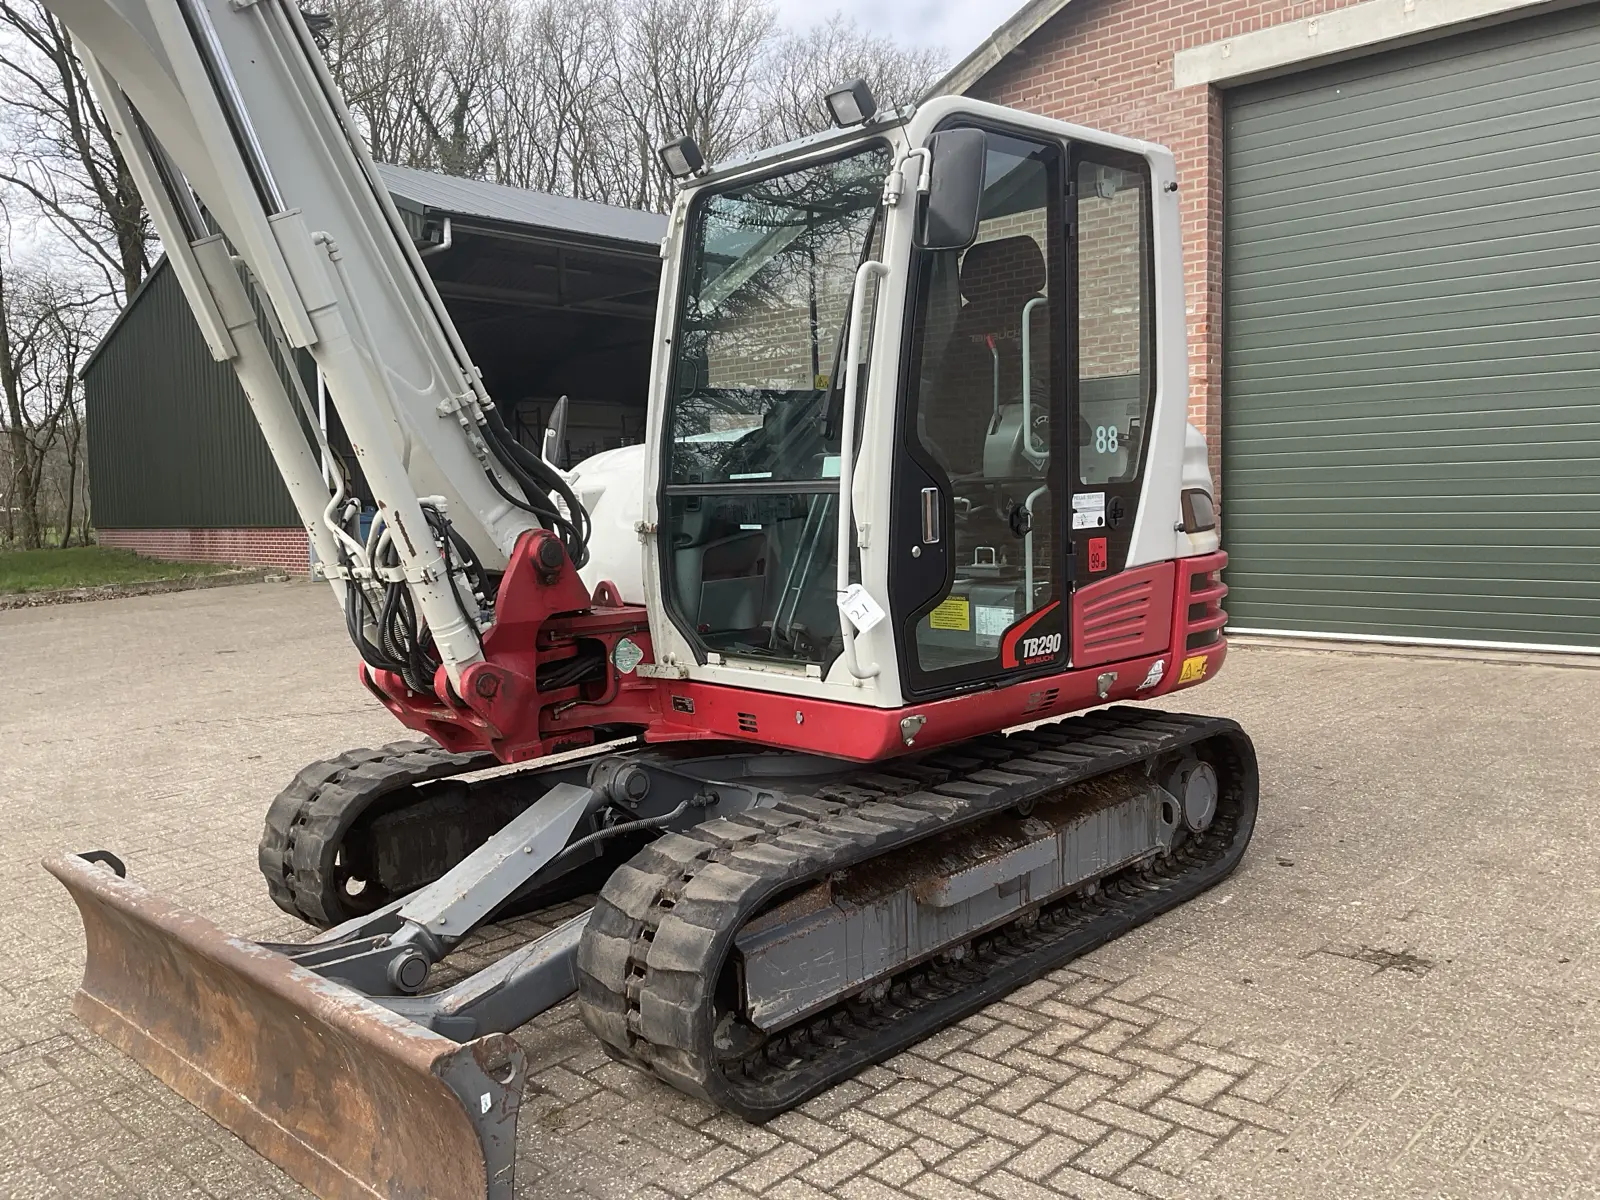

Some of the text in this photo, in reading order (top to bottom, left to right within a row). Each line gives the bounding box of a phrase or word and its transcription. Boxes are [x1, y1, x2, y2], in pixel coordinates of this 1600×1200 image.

[969, 328, 1021, 343] TAKEUCH
[1095, 425, 1118, 454] 88
[1091, 552, 1100, 568] 99
[850, 603, 869, 620] 21
[1023, 633, 1062, 658] TB290
